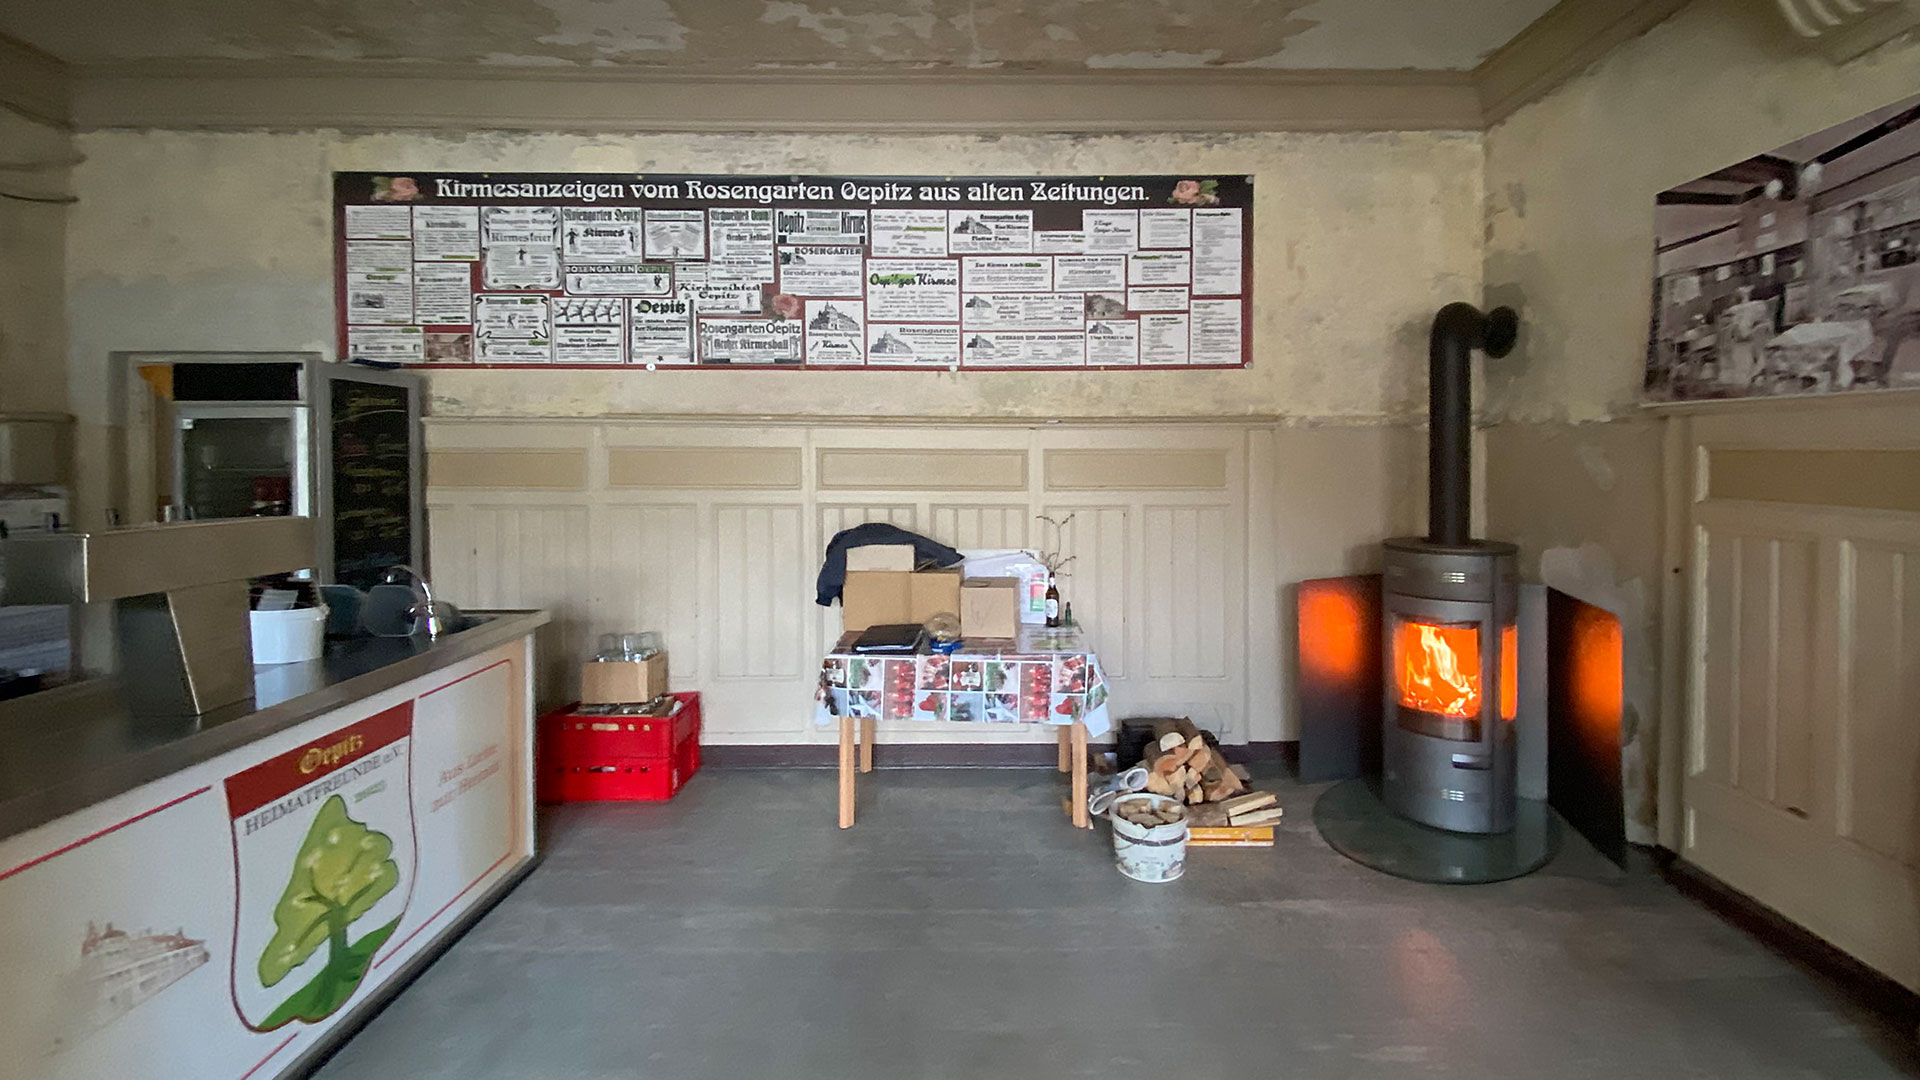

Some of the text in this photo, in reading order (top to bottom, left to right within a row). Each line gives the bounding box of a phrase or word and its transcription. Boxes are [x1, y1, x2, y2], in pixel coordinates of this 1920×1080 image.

[436, 178, 1150, 206] Kirmesanzeigen vom Rosengarten Oepitz aus alten Zeitungen.
[778, 211, 804, 235] Oepitz
[583, 227, 625, 238] Kirmes
[794, 247, 862, 255] ROSENGARTEN
[565, 265, 635, 274] ROSENGARTEN
[700, 322, 801, 335] Rosengarten Oepitz
[899, 327, 957, 335] Rosengarten
[244, 755, 381, 836] HEIMATFREUNDE
